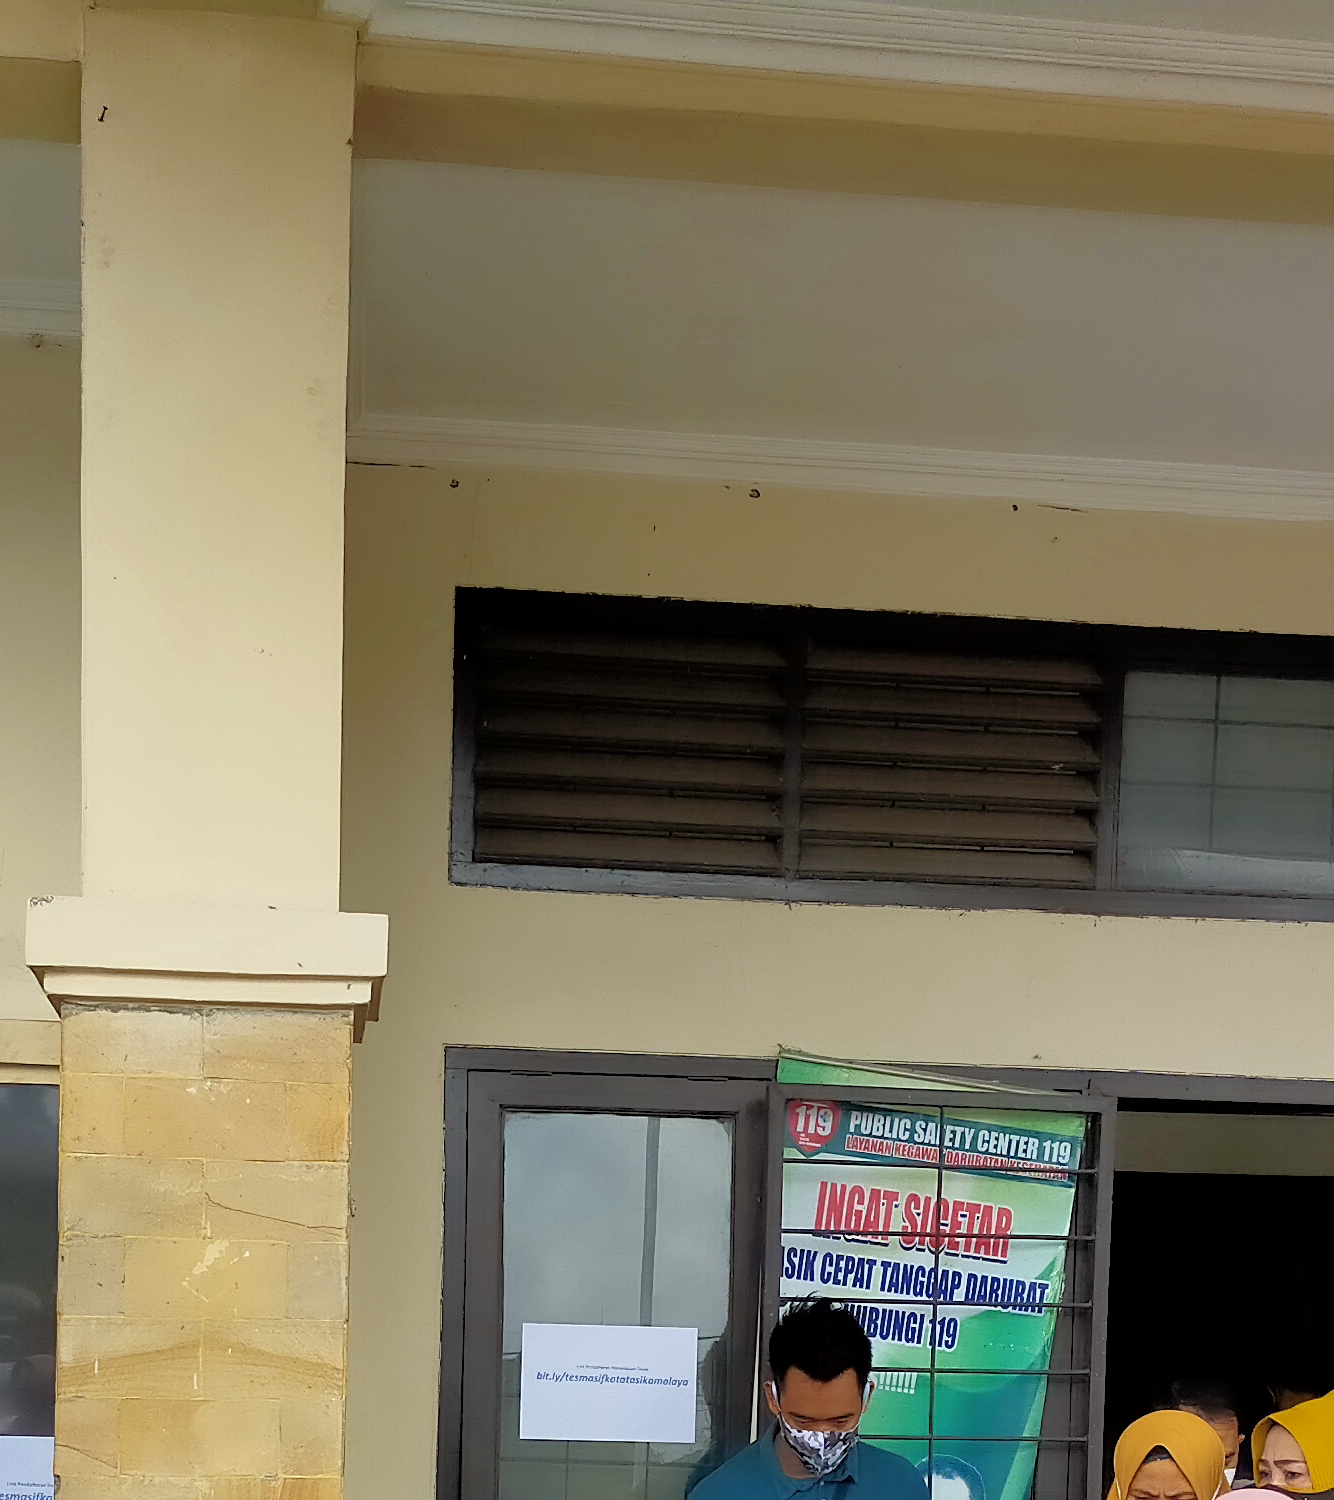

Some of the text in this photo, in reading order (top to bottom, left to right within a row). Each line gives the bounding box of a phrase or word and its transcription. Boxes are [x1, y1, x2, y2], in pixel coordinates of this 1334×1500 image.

[796, 1105, 833, 1136] 119
[849, 1111, 911, 1140] PUBLIC
[977, 1130, 1039, 1160] CENTER
[1042, 1140, 1071, 1164] 119
[845, 1134, 893, 1157] LAYANAN
[814, 1181, 1013, 1263] INGAT SICETAR
[820, 1252, 877, 1290] CEPAT
[880, 1260, 962, 1302] TANGGAP
[965, 1273, 1050, 1314] DARURAT
[928, 1316, 959, 1349] 119
